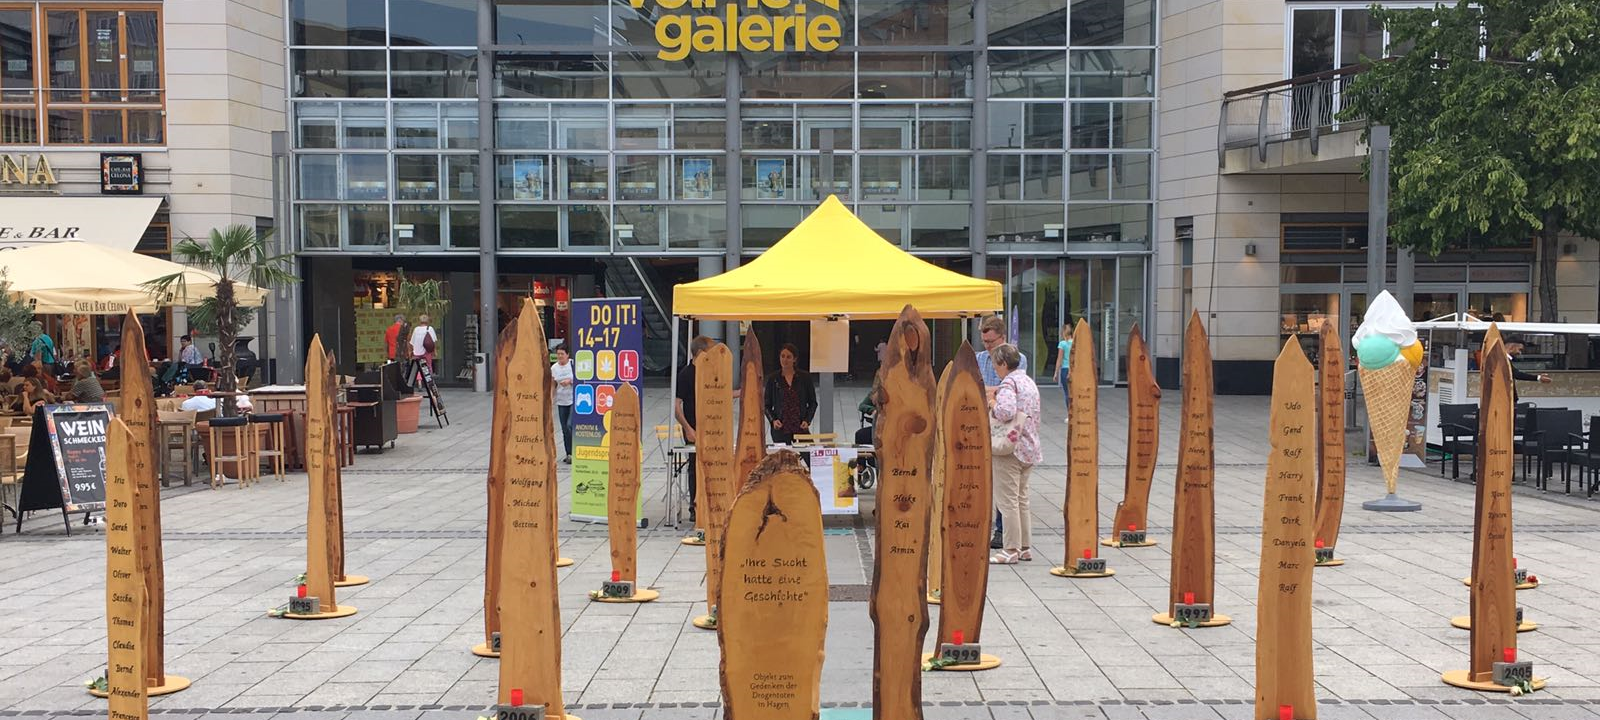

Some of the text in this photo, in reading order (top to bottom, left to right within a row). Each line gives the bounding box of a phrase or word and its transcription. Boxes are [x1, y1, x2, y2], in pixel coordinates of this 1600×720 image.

[654, 3, 842, 61] galerie
[28, 226, 80, 238] BAR
[590, 304, 612, 326] DO
[616, 304, 636, 325] IT!
[578, 327, 620, 348] 14-17
[1284, 402, 1302, 410] Udo
[515, 414, 538, 422] Sascha
[60, 420, 106, 436] WEIN
[1283, 426, 1303, 434] Gerd
[1283, 448, 1302, 458] Ralf
[892, 468, 918, 476] Bernd
[1278, 472, 1304, 482] Harry
[114, 476, 125, 484] Iris
[510, 478, 544, 488] Wolfgang
[114, 499, 128, 508] Doro
[512, 499, 540, 508] Michael
[893, 494, 916, 504] Heike
[1278, 494, 1304, 504] Frank
[894, 520, 910, 529] Kai
[1280, 516, 1302, 526] Dirk
[110, 522, 128, 532] Sarah
[110, 546, 132, 556] Walter
[890, 546, 915, 554] Armin
[772, 558, 808, 568] Sucht
[1081, 562, 1106, 570] 2007
[1278, 561, 1300, 570] Marc
[112, 570, 131, 579] Oliver
[744, 574, 801, 584] hatte eine
[1278, 584, 1298, 594] Ralf
[112, 594, 132, 603] Sascha
[1176, 608, 1210, 619] 1997
[112, 616, 134, 628] Thomas
[112, 640, 135, 650] Claudia
[116, 664, 134, 674] Bernd
[754, 674, 777, 682] Objekt
[750, 682, 784, 690] Gedenken
[110, 686, 140, 698] Alexander
[752, 692, 796, 700] Drogentoten
[766, 701, 789, 710] Hagen
